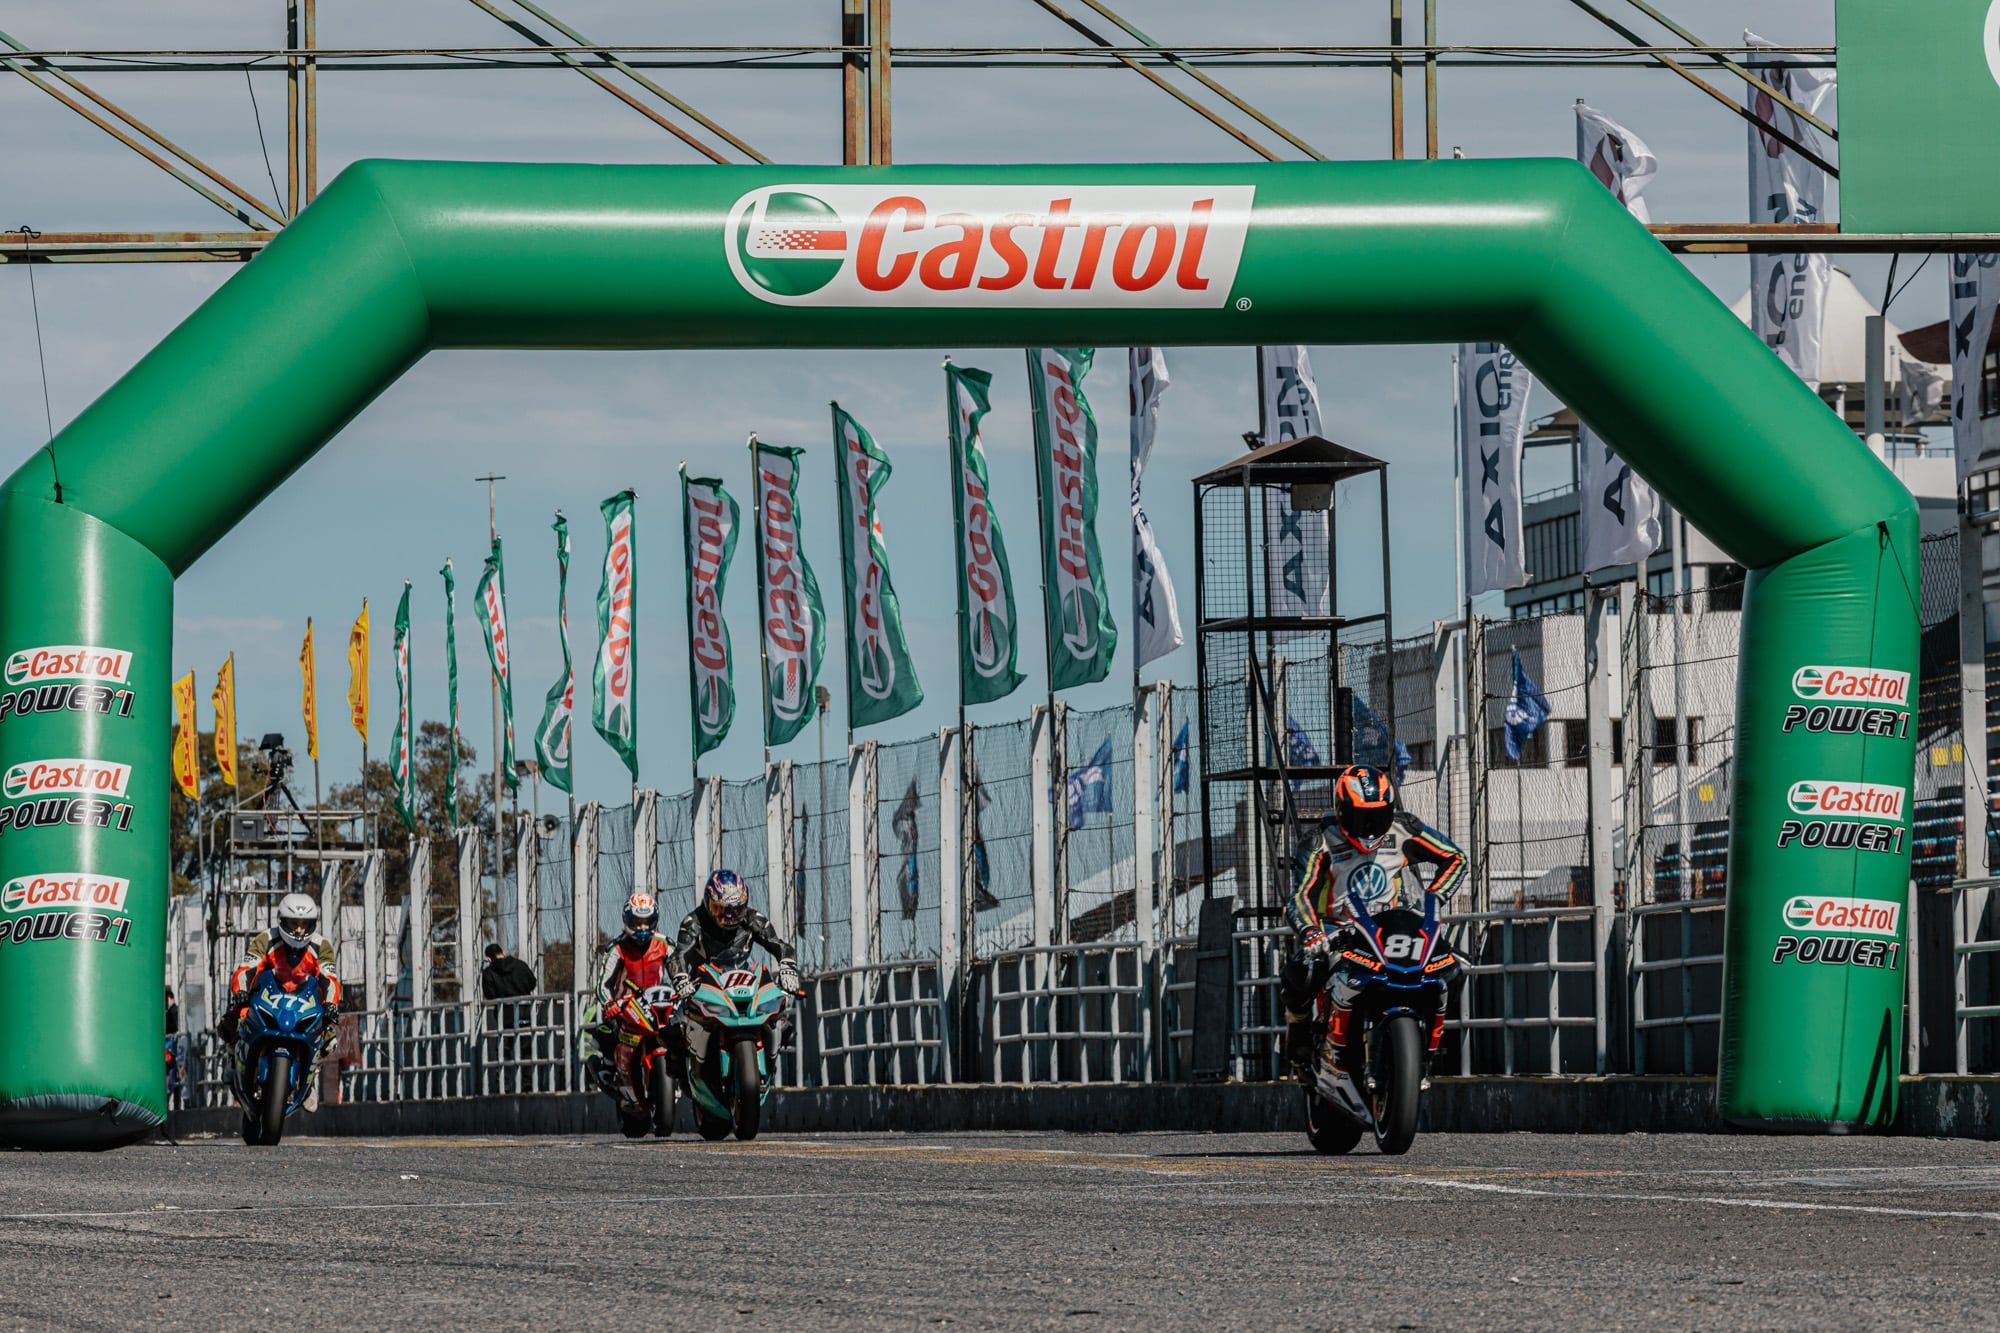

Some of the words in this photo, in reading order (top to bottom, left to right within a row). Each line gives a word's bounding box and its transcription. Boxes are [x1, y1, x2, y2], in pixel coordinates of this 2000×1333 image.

[855, 195, 1214, 292] Castrol
[1499, 350, 1517, 412] ene
[1047, 360, 1089, 581] Castrol
[1275, 366, 1307, 604] AXN
[963, 470, 998, 602] Cast
[762, 470, 806, 653] Castrol
[692, 497, 727, 670] Castrol
[31, 650, 123, 678] Castrol
[1825, 670, 1905, 700] Castrol
[1782, 704, 1911, 740] POWER1
[28, 763, 122, 791] Castrol
[1820, 785, 1900, 815] Castrol
[1777, 819, 1906, 855] POWER1
[27, 878, 120, 905] Castrol
[1815, 901, 1895, 930] Castrol
[1384, 934, 1425, 961] 81
[1772, 935, 1900, 970] POWER1
[269, 993, 310, 1013] 777
